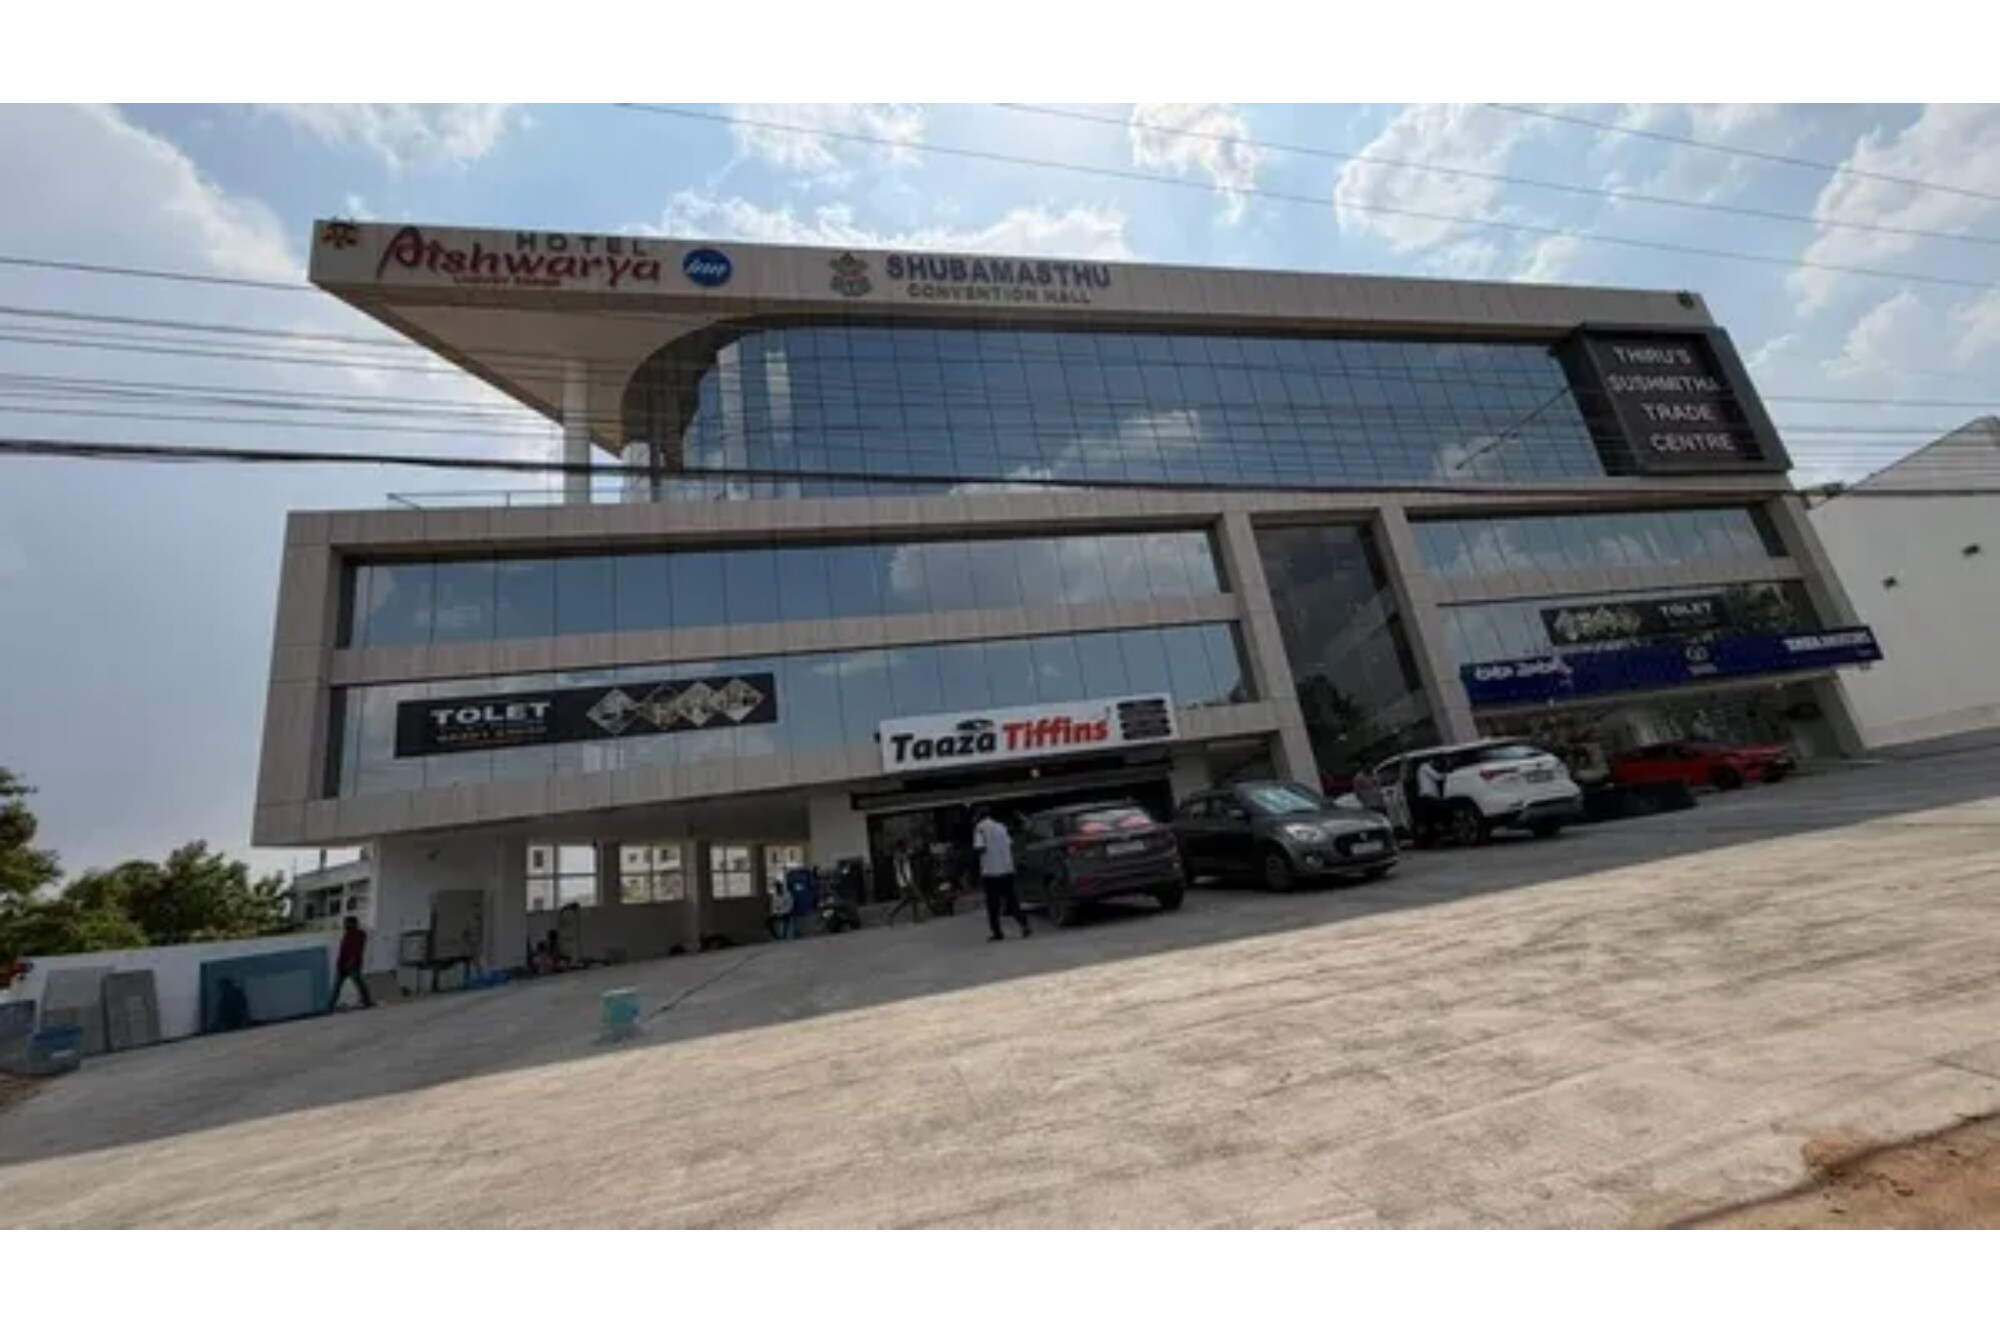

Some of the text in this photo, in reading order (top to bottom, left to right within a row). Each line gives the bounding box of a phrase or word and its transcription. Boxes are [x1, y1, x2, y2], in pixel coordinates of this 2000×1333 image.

[516, 232, 649, 256] HOTEL
[376, 226, 660, 287] Aishwarya
[886, 254, 1111, 288] SHUBAMASTHU
[906, 282, 1091, 303] CONVENTION HALL
[1641, 402, 1716, 421] TRADE
[1650, 432, 1737, 452] CENTRE
[430, 702, 550, 725] TOLET
[890, 731, 997, 762] Taaza
[1002, 716, 1108, 751] Tiffins
